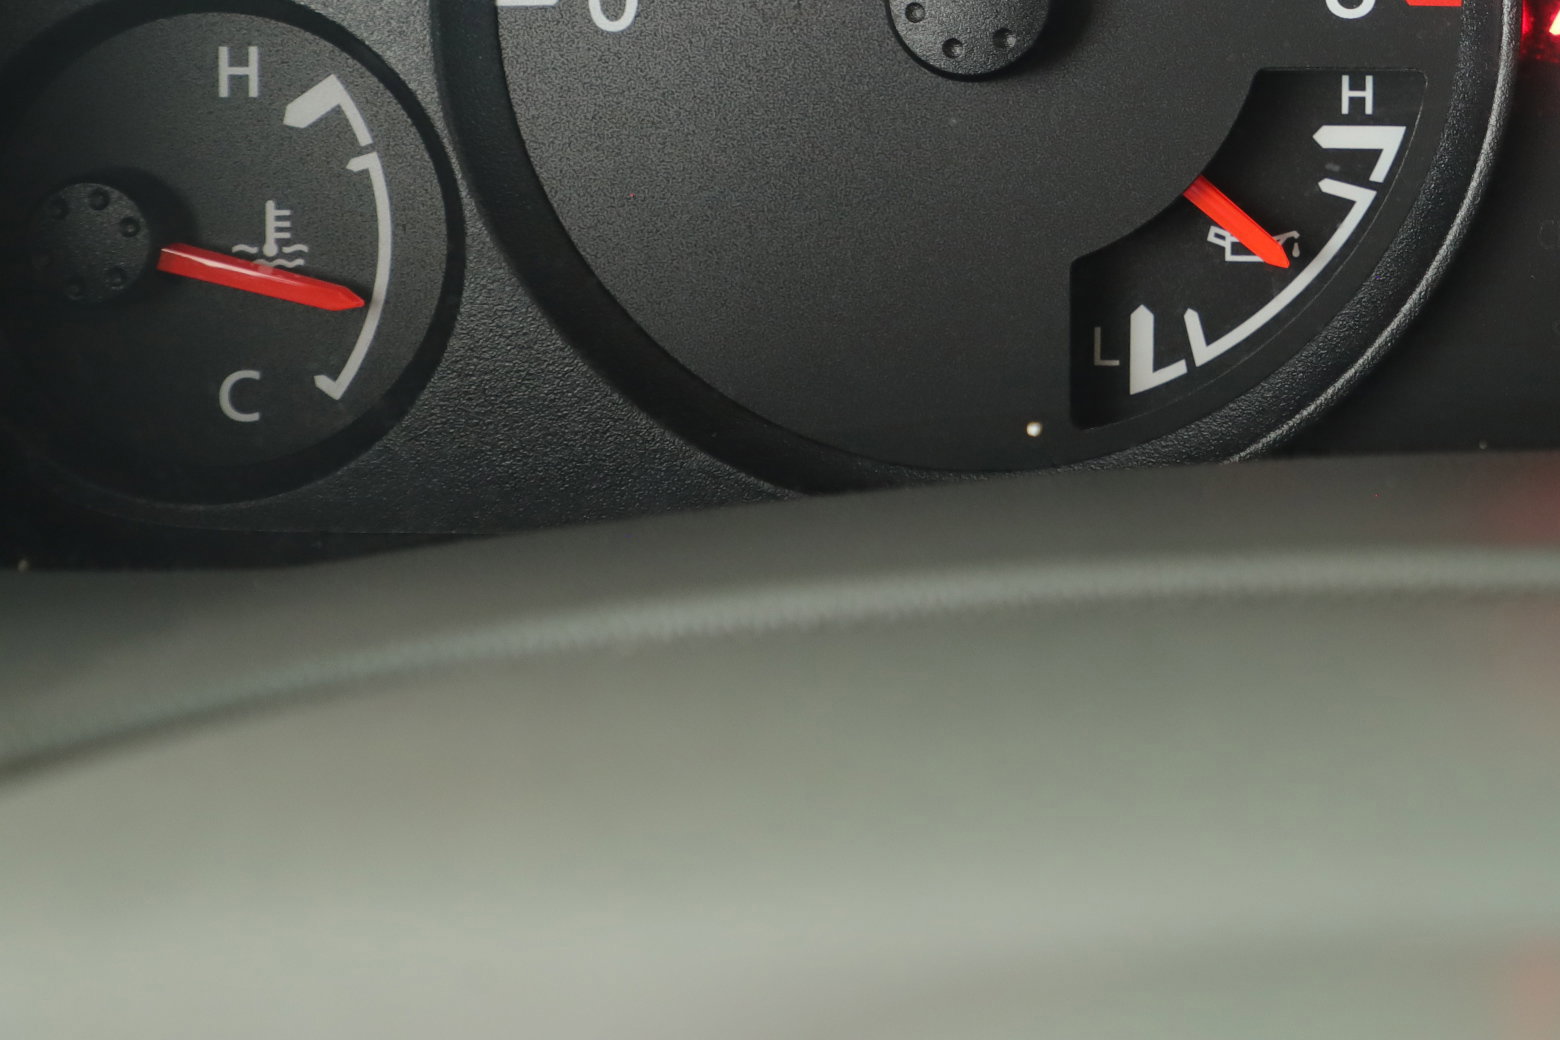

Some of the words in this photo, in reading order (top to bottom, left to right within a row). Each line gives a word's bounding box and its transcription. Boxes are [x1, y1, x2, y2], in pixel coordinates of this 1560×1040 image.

[218, 45, 260, 98] H
[1341, 75, 1374, 115] H
[1094, 327, 1120, 366] L
[219, 370, 261, 422] C
